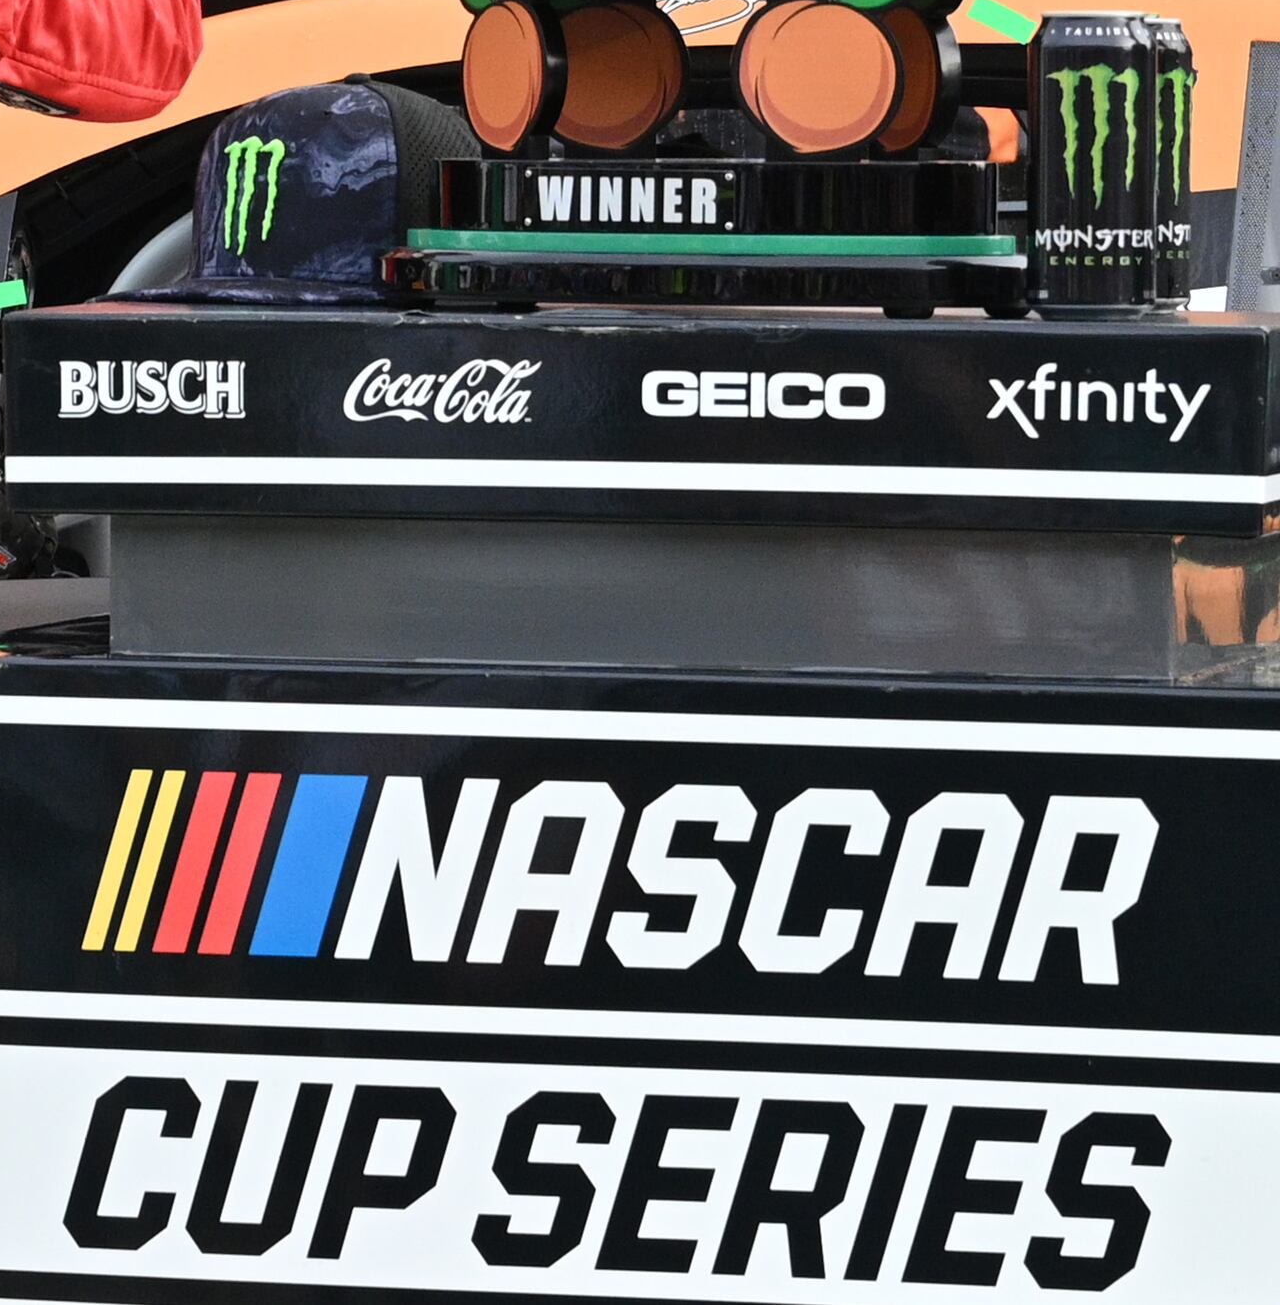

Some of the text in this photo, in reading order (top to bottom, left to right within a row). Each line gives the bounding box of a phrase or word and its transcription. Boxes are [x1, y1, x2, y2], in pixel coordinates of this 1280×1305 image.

[538, 176, 717, 225] WINNER
[1049, 255, 1144, 267] ENERGY
[58, 357, 1211, 443] BUSCH Coca-Cola GEICO xfinity
[335, 774, 1160, 985] NASCAR
[62, 1074, 1173, 1292] CUP SERIES
